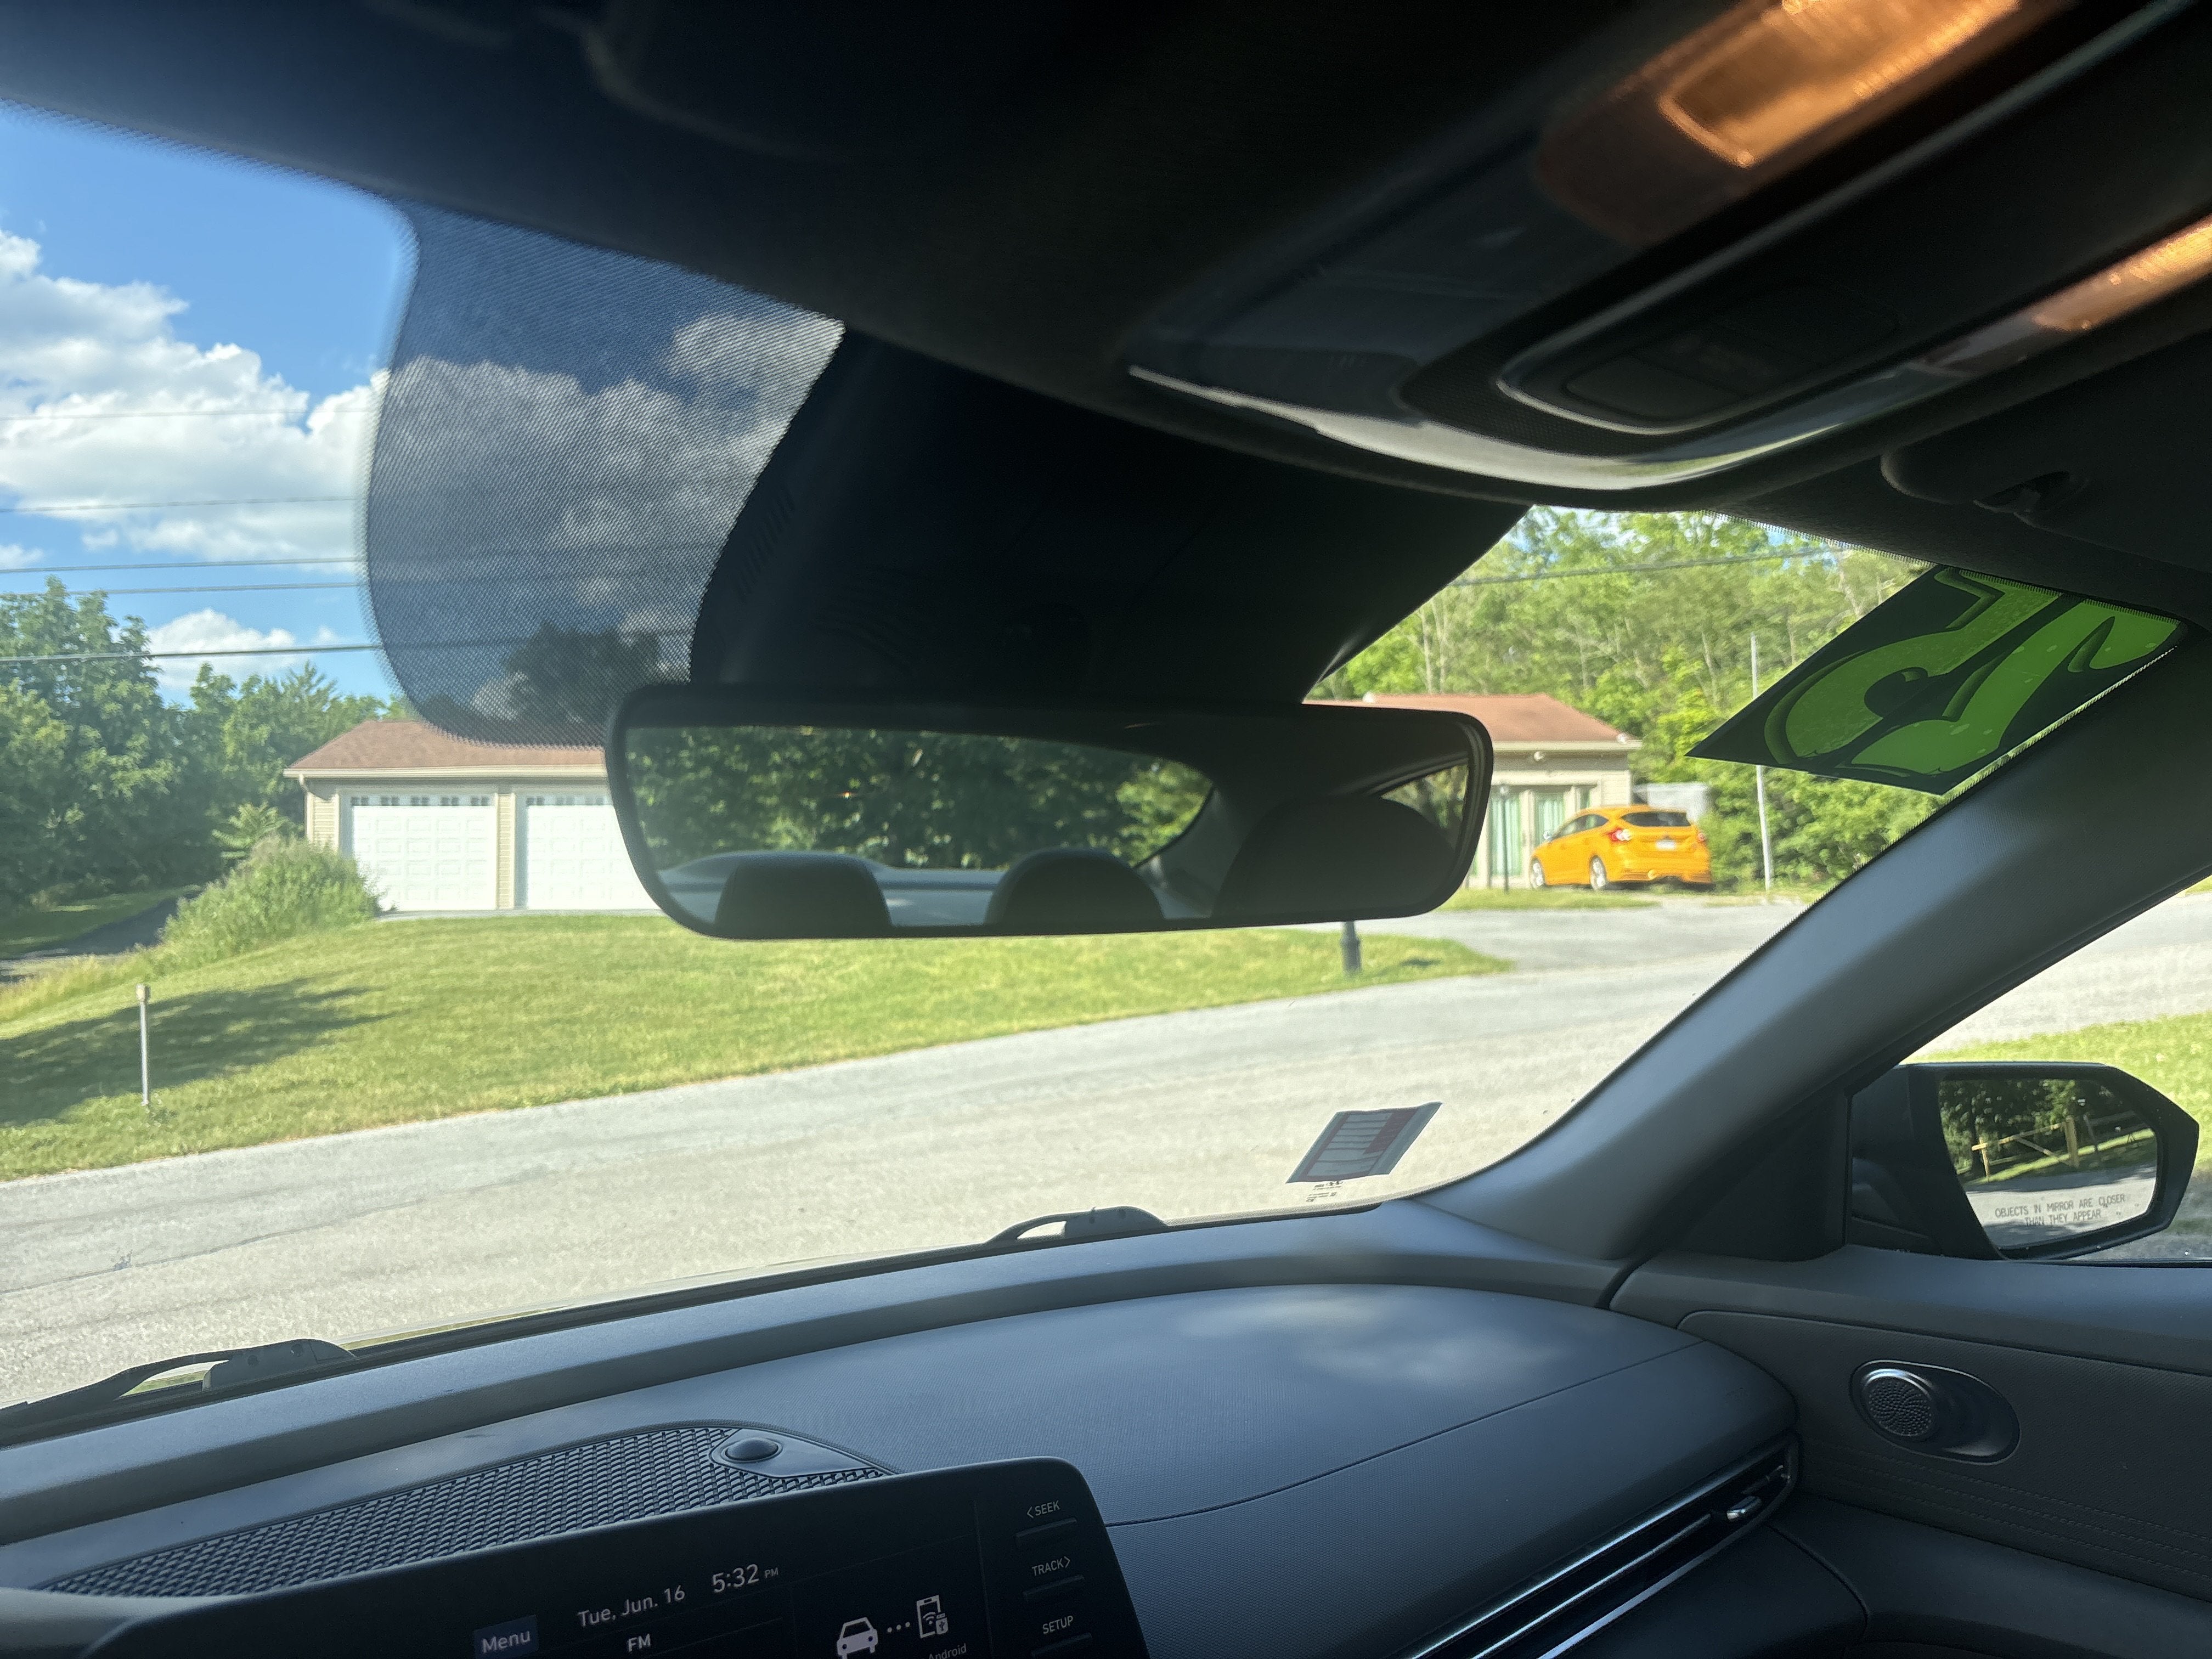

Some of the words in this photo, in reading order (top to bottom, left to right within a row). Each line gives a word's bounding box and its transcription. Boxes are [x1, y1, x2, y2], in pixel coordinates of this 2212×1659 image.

[1995, 1206, 2029, 1218] OBJECTS
[2034, 1204, 2041, 1214] IN
[2047, 1200, 2074, 1212] MIRROR
[2079, 1198, 2094, 1208] ARE
[2098, 1193, 2126, 1206] CLOSER
[2024, 1216, 2044, 1226] THAN
[2049, 1213, 2069, 1224] THEY
[2073, 1209, 2102, 1222] APPEAR
[712, 1564, 760, 1593] 5:32
[765, 1567, 778, 1578] PM
[578, 1609, 616, 1628] Tue,
[621, 1598, 659, 1616] Jun.
[664, 1585, 686, 1603] 16
[1042, 1615, 1074, 1634] SETUP
[481, 1629, 531, 1654] Menu
[627, 1633, 651, 1652] FM
